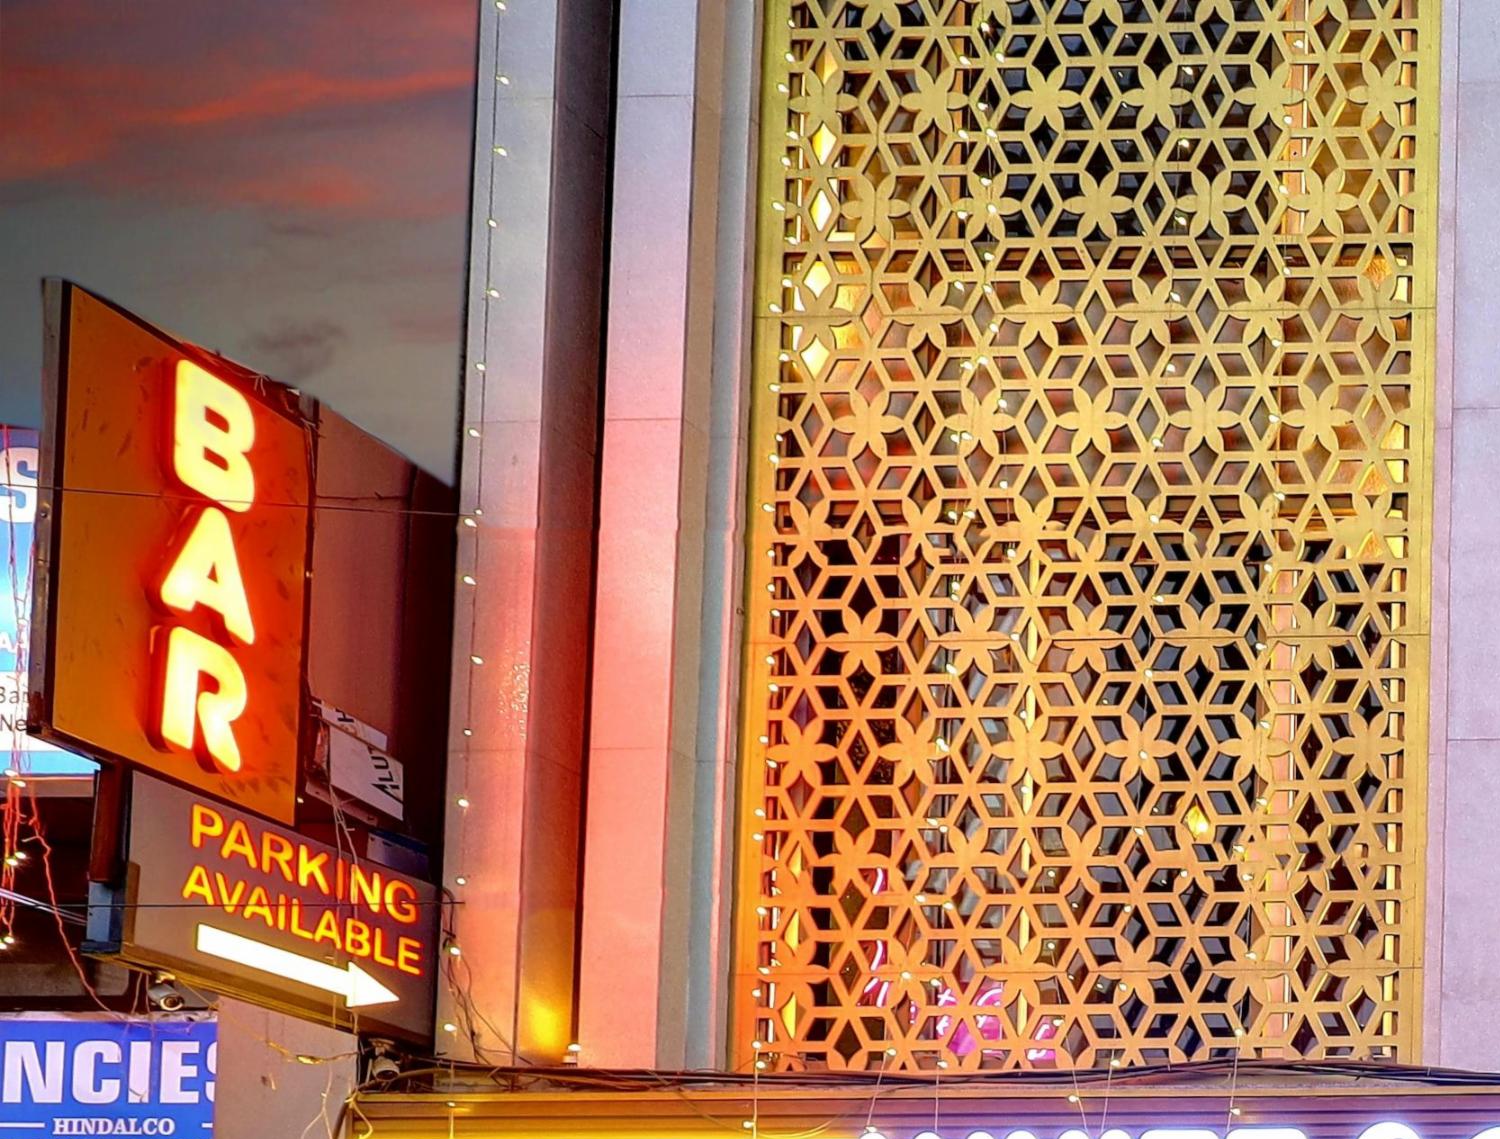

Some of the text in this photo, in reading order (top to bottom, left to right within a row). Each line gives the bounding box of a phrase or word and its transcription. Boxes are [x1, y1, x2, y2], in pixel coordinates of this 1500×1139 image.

[160, 358, 256, 772] BAR
[182, 865, 424, 976] AVAILABLE
[188, 803, 418, 925] PARKING
[52, 1117, 176, 1136] HINDALCO
